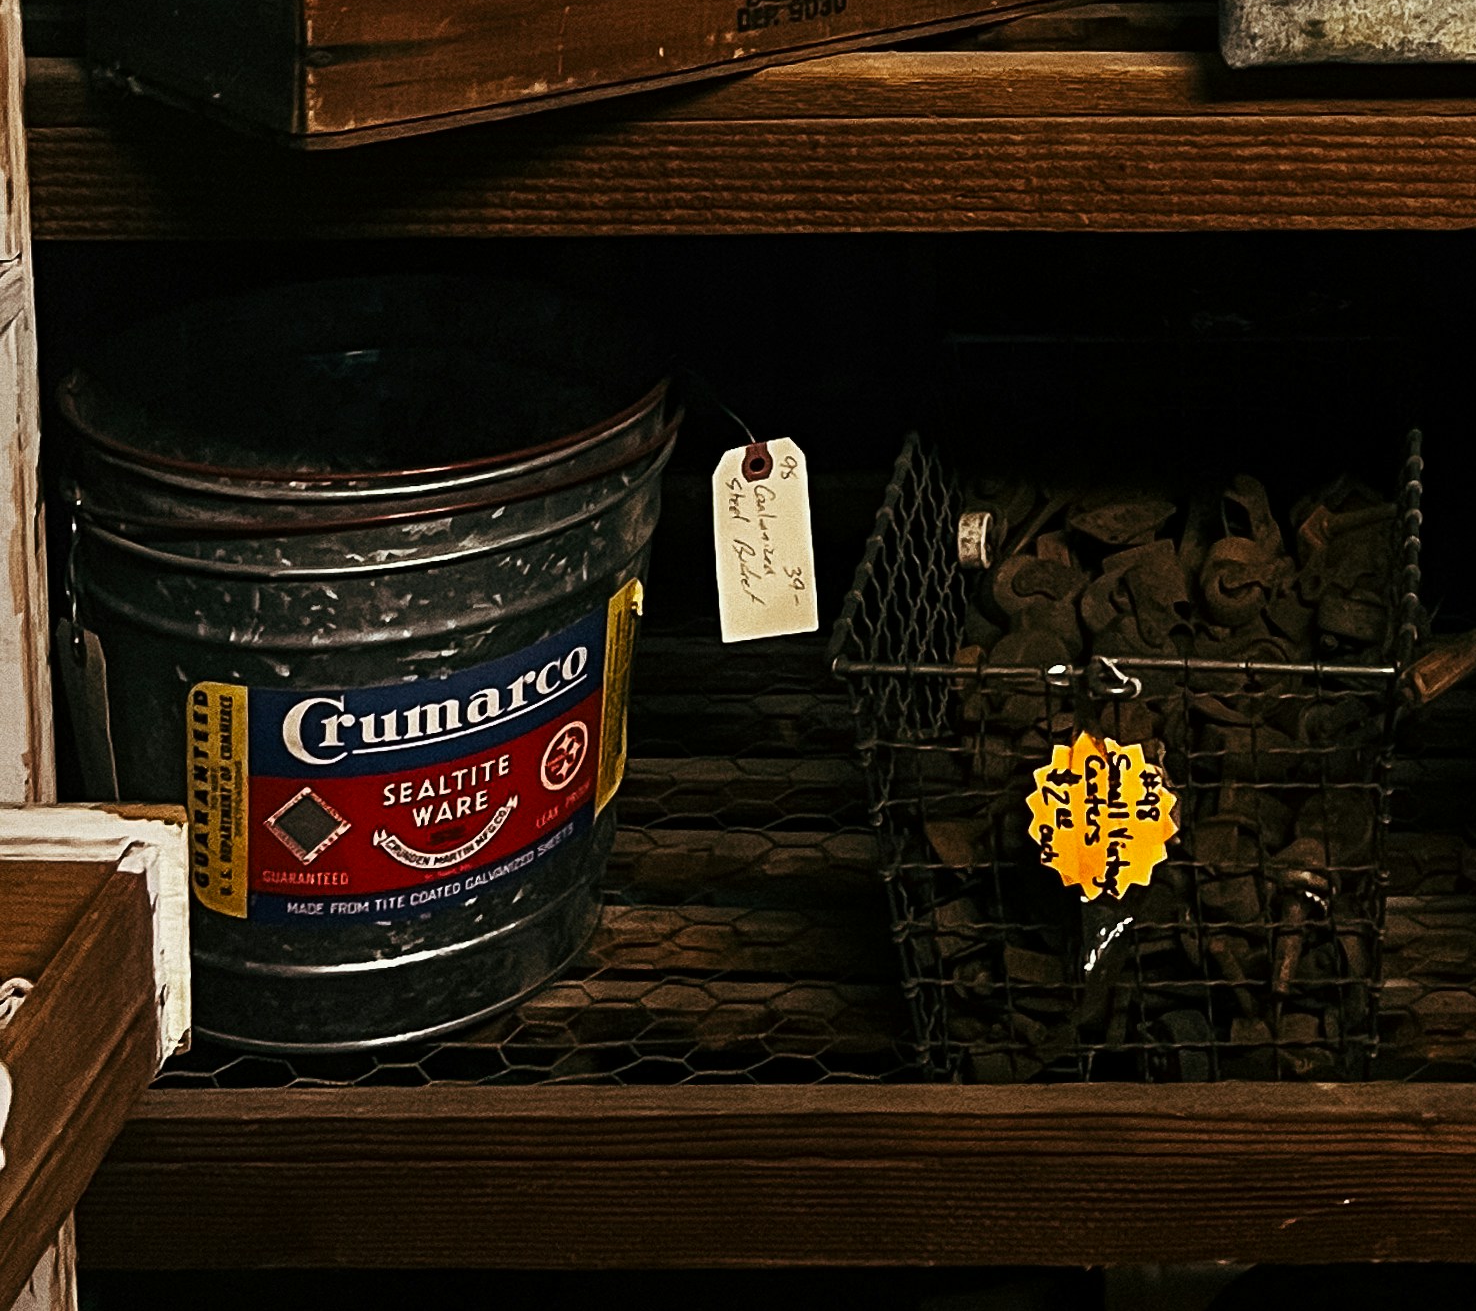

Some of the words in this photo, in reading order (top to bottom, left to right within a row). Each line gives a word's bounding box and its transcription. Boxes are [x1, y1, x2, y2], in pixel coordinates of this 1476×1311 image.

[281, 644, 589, 767] Crumarco
[193, 689, 210, 889] GUARANTEED
[382, 754, 511, 807] SEALTITE
[411, 789, 490, 828] WARE
[1084, 754, 1108, 847] Casters
[1106, 750, 1132, 820] Small
[262, 869, 350, 887] GUARANTEED
[286, 902, 325, 915] MADE
[329, 901, 370, 915] FROM
[374, 894, 406, 913] TITE
[409, 882, 462, 907] COATED
[464, 849, 536, 891] GALVANIZED
[536, 821, 575, 859] SHEETS
[432, 842, 475, 867] MARTIN
